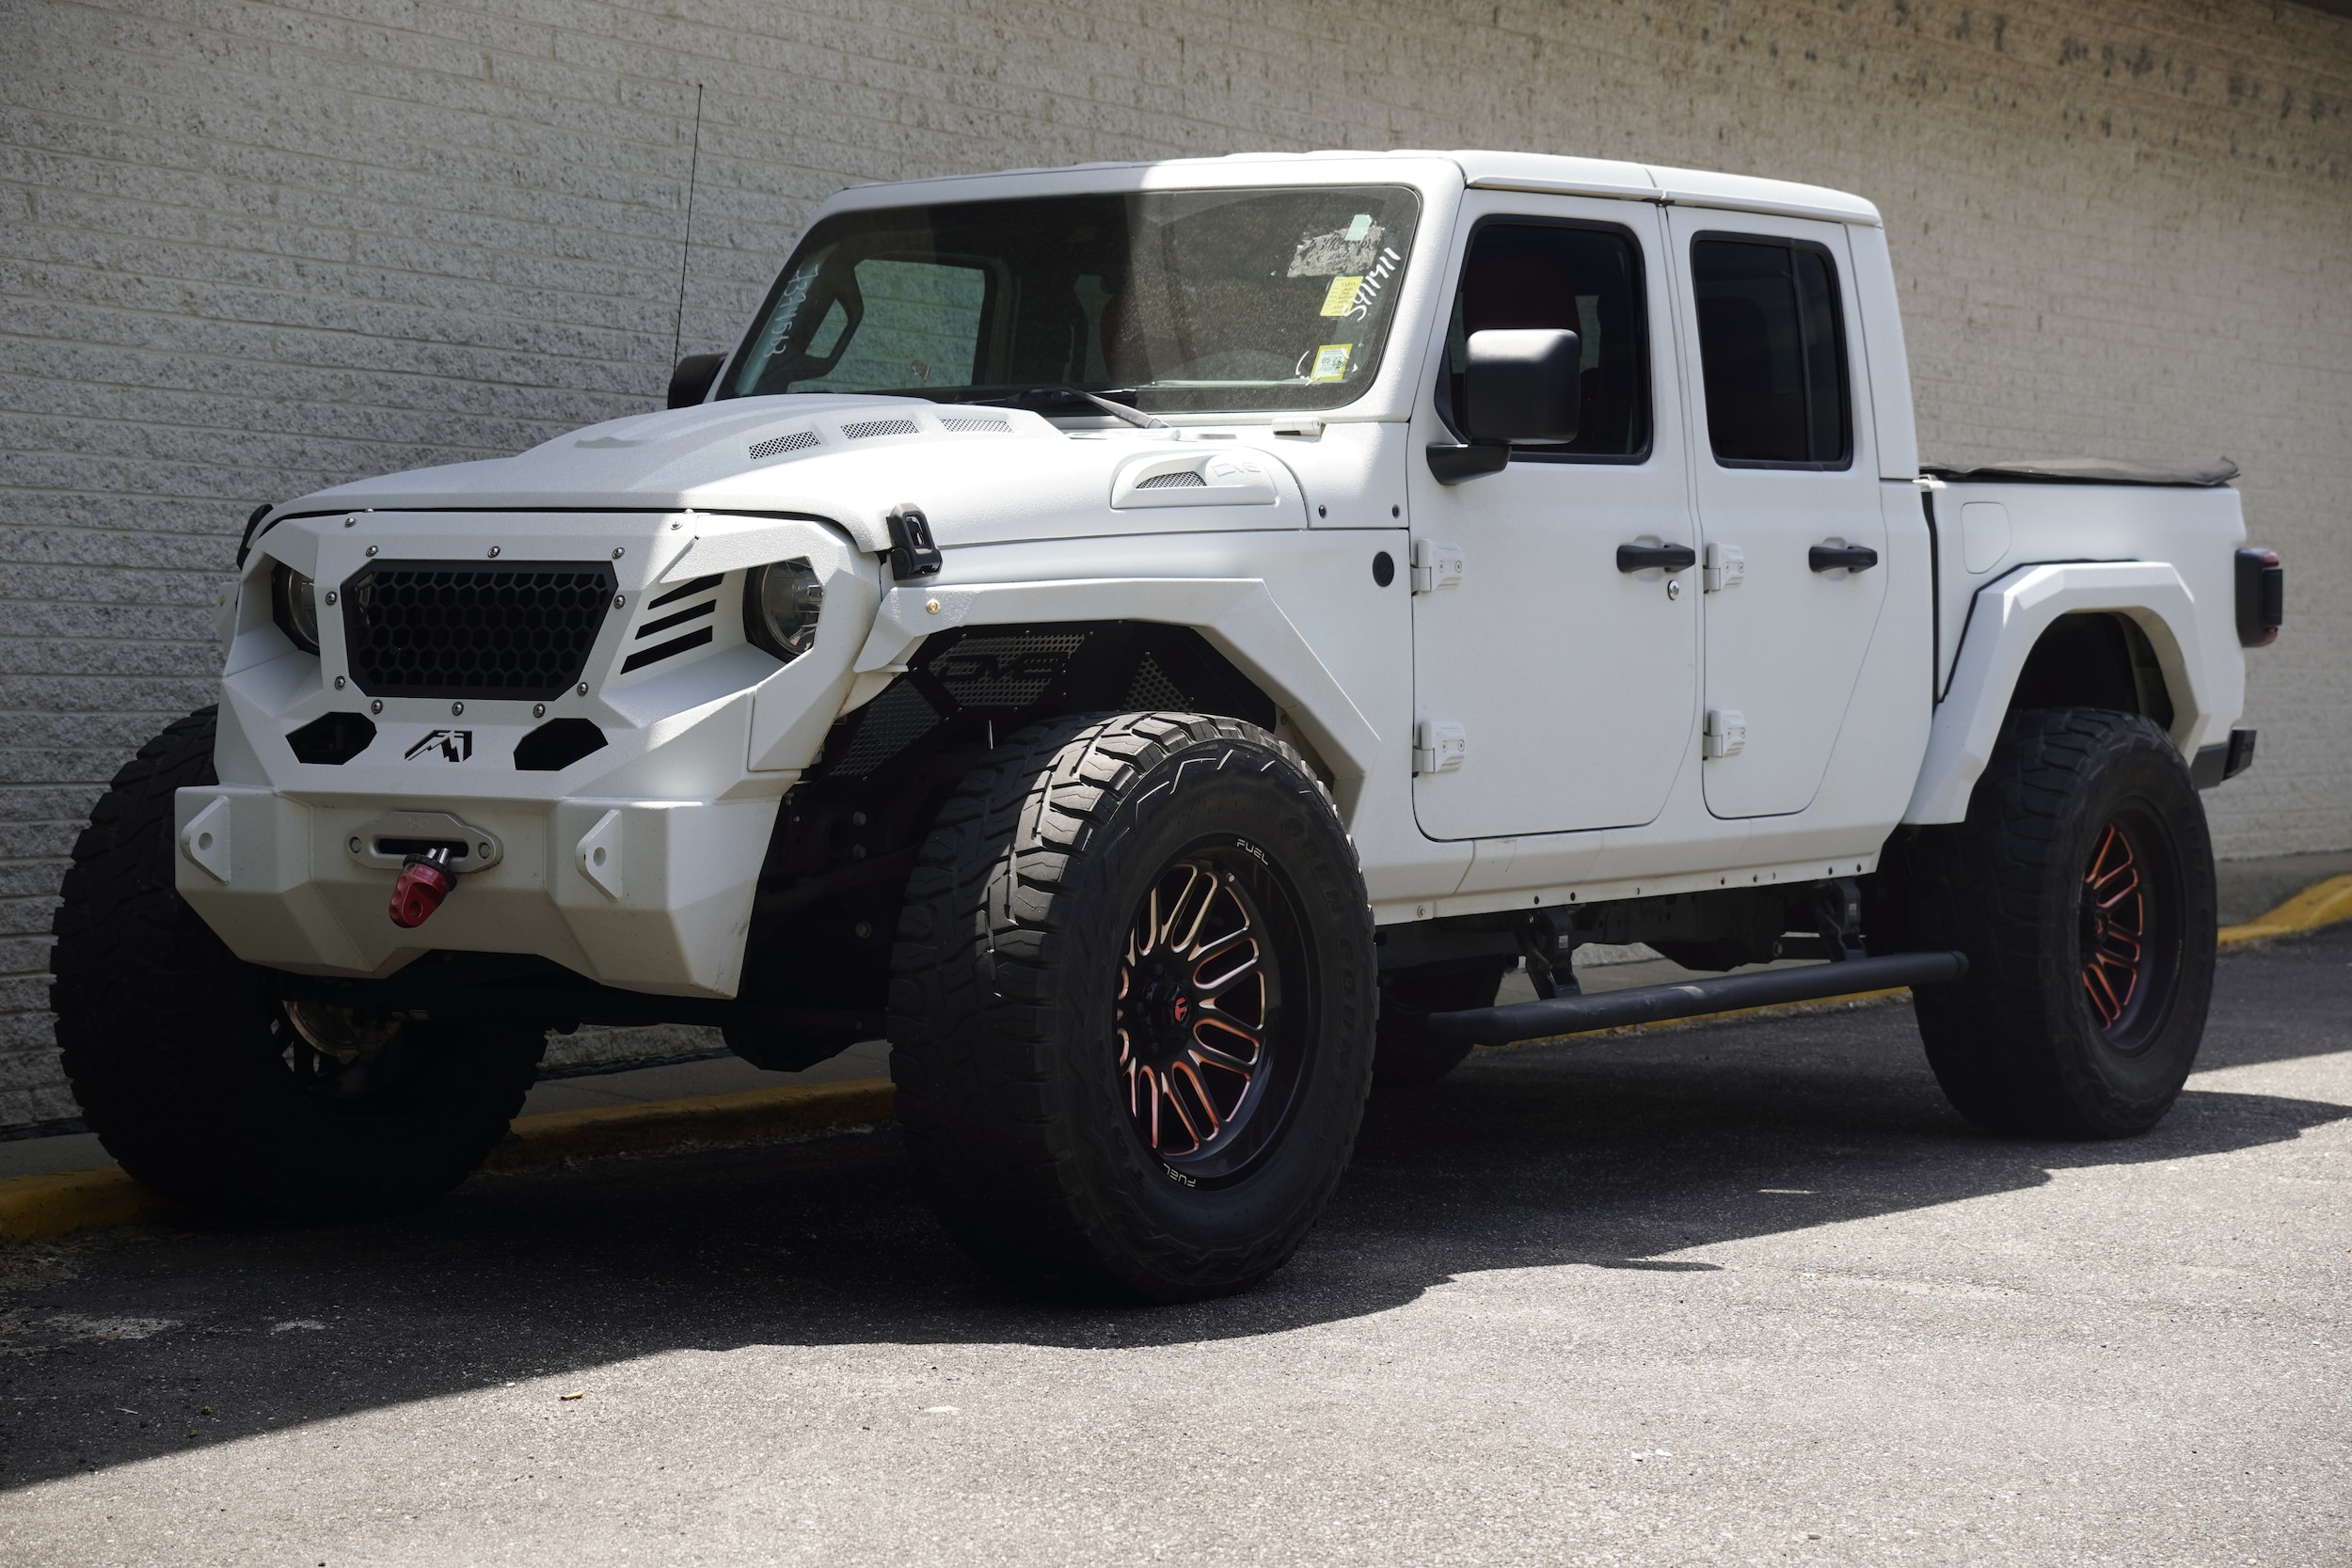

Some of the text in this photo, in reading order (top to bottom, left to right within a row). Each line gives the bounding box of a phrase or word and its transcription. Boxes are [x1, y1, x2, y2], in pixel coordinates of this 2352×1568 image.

[1236, 837, 1269, 866] FUEL
[1280, 816, 1345, 917] OPEN
[1163, 1162, 1197, 1188] FUEL
